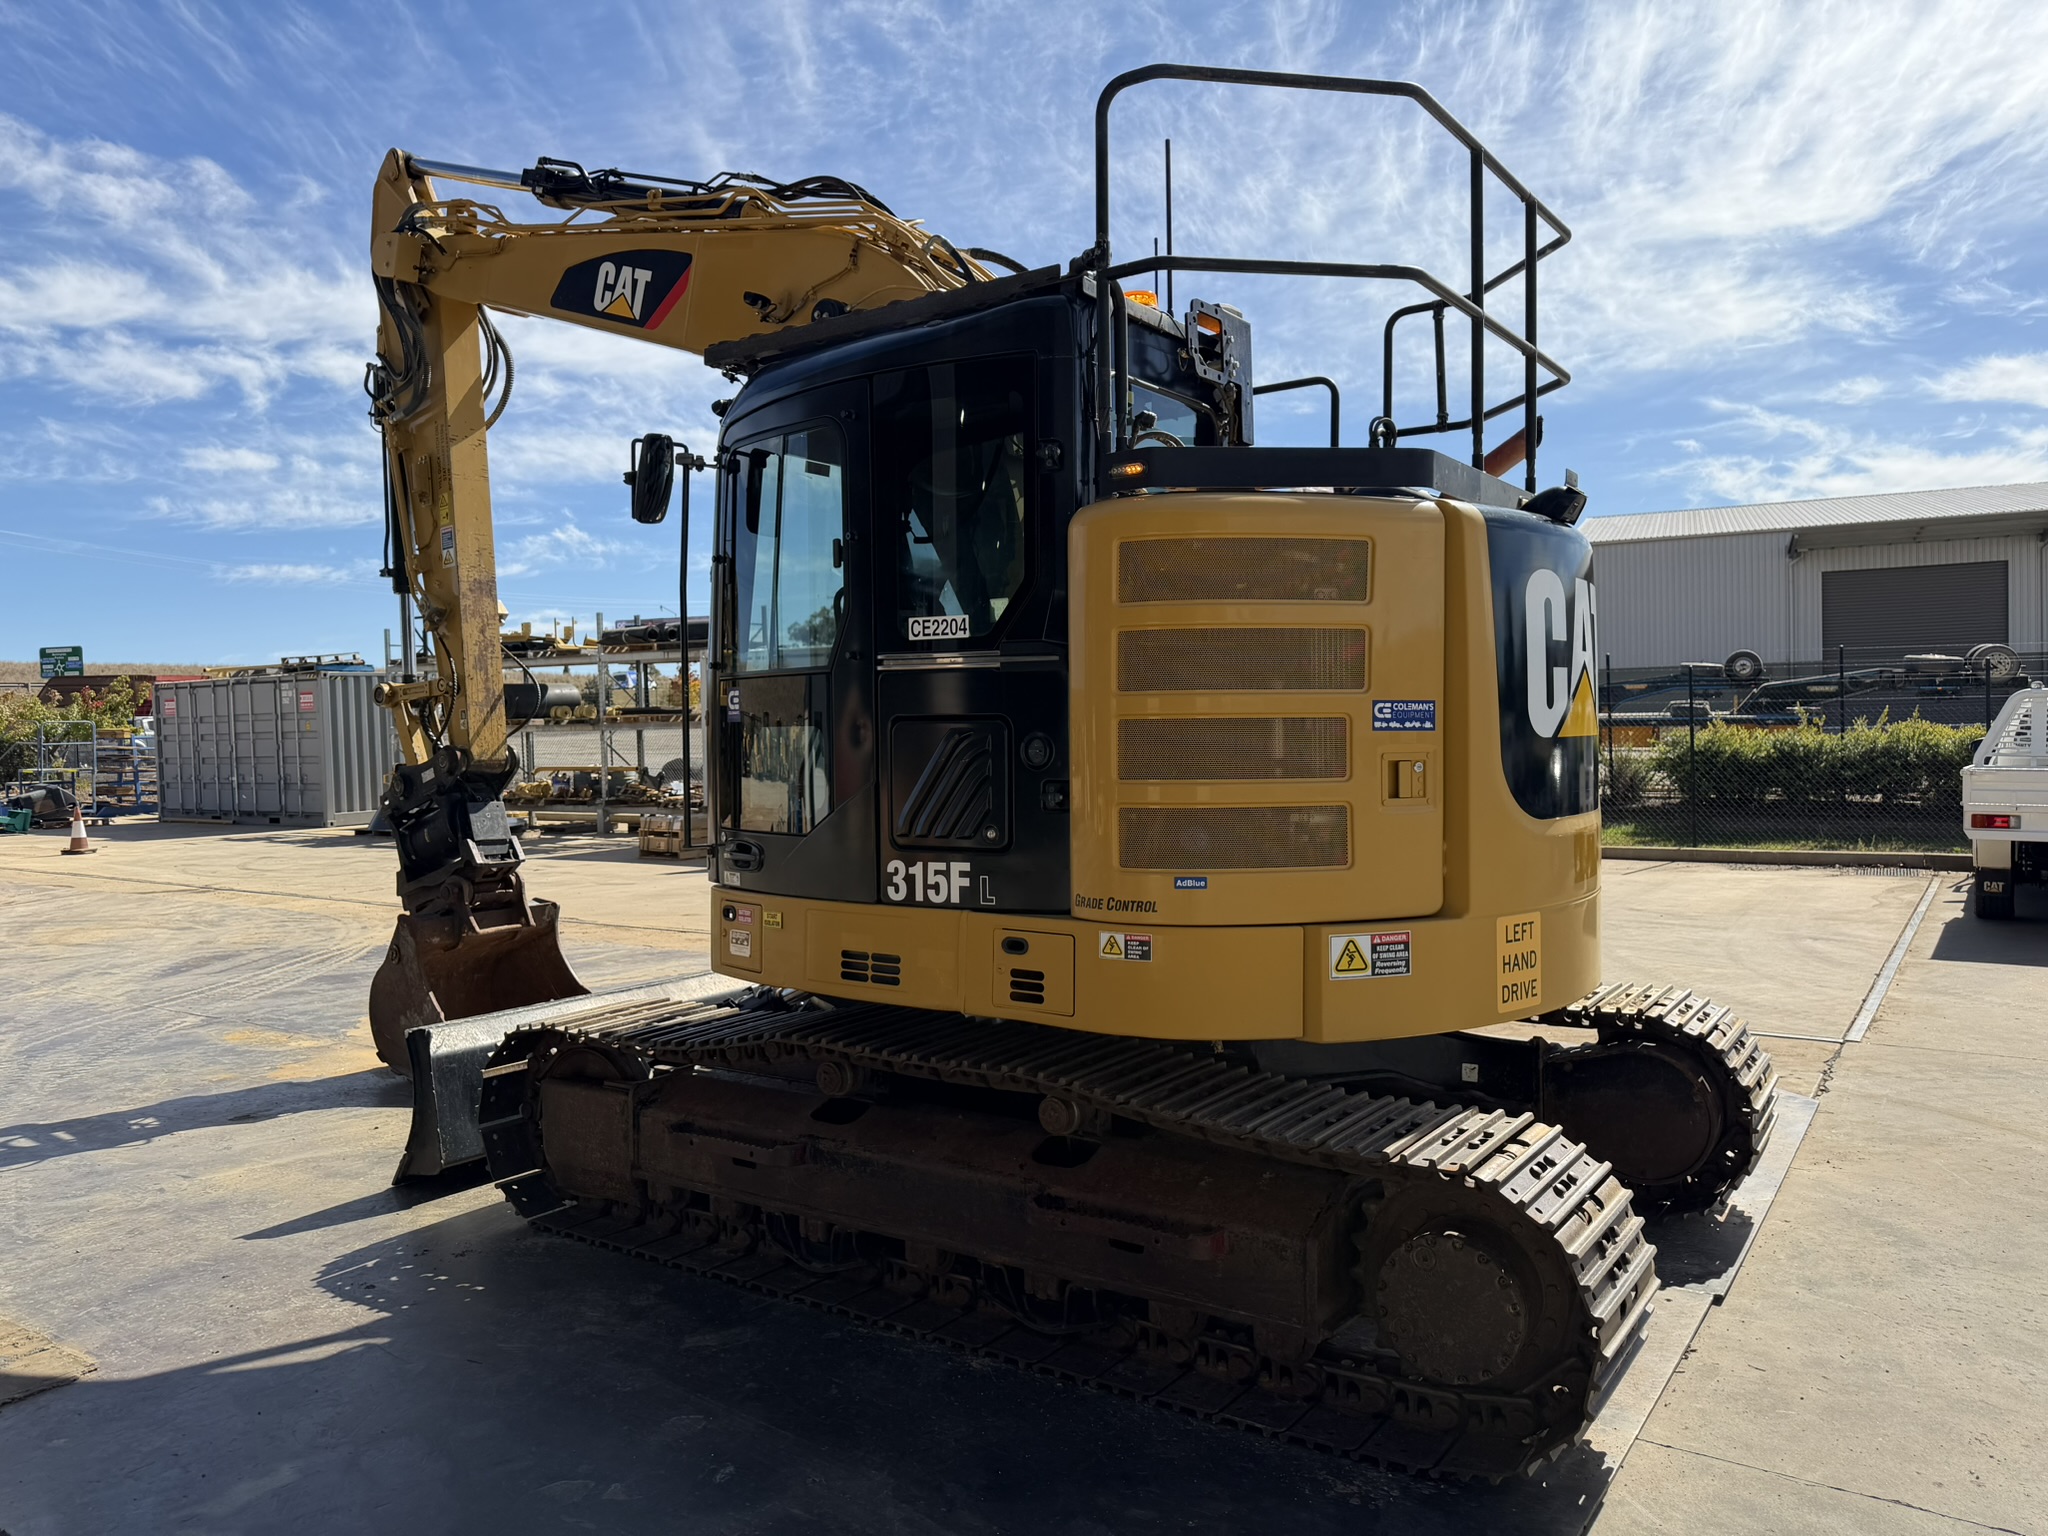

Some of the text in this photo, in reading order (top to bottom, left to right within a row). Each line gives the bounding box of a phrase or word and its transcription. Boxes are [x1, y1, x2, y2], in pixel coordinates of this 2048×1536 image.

[593, 261, 653, 320] CAT
[911, 618, 967, 637] CE2204
[1392, 702, 1434, 711] COLEMAN'S
[1392, 711, 1434, 719] EQUIPMENT
[887, 859, 996, 905] 315F L
[1176, 879, 1206, 887] AdBlue
[1983, 881, 2005, 892] CAT
[1505, 921, 1535, 944] LEFT
[1381, 934, 1407, 943] DANGER
[1376, 943, 1405, 952] KEEP CLEAR
[1375, 960, 1406, 968] Reversing
[1502, 950, 1537, 974] HAND
[1374, 966, 1408, 975] Frequently
[1502, 978, 1538, 1004] DRIVE
